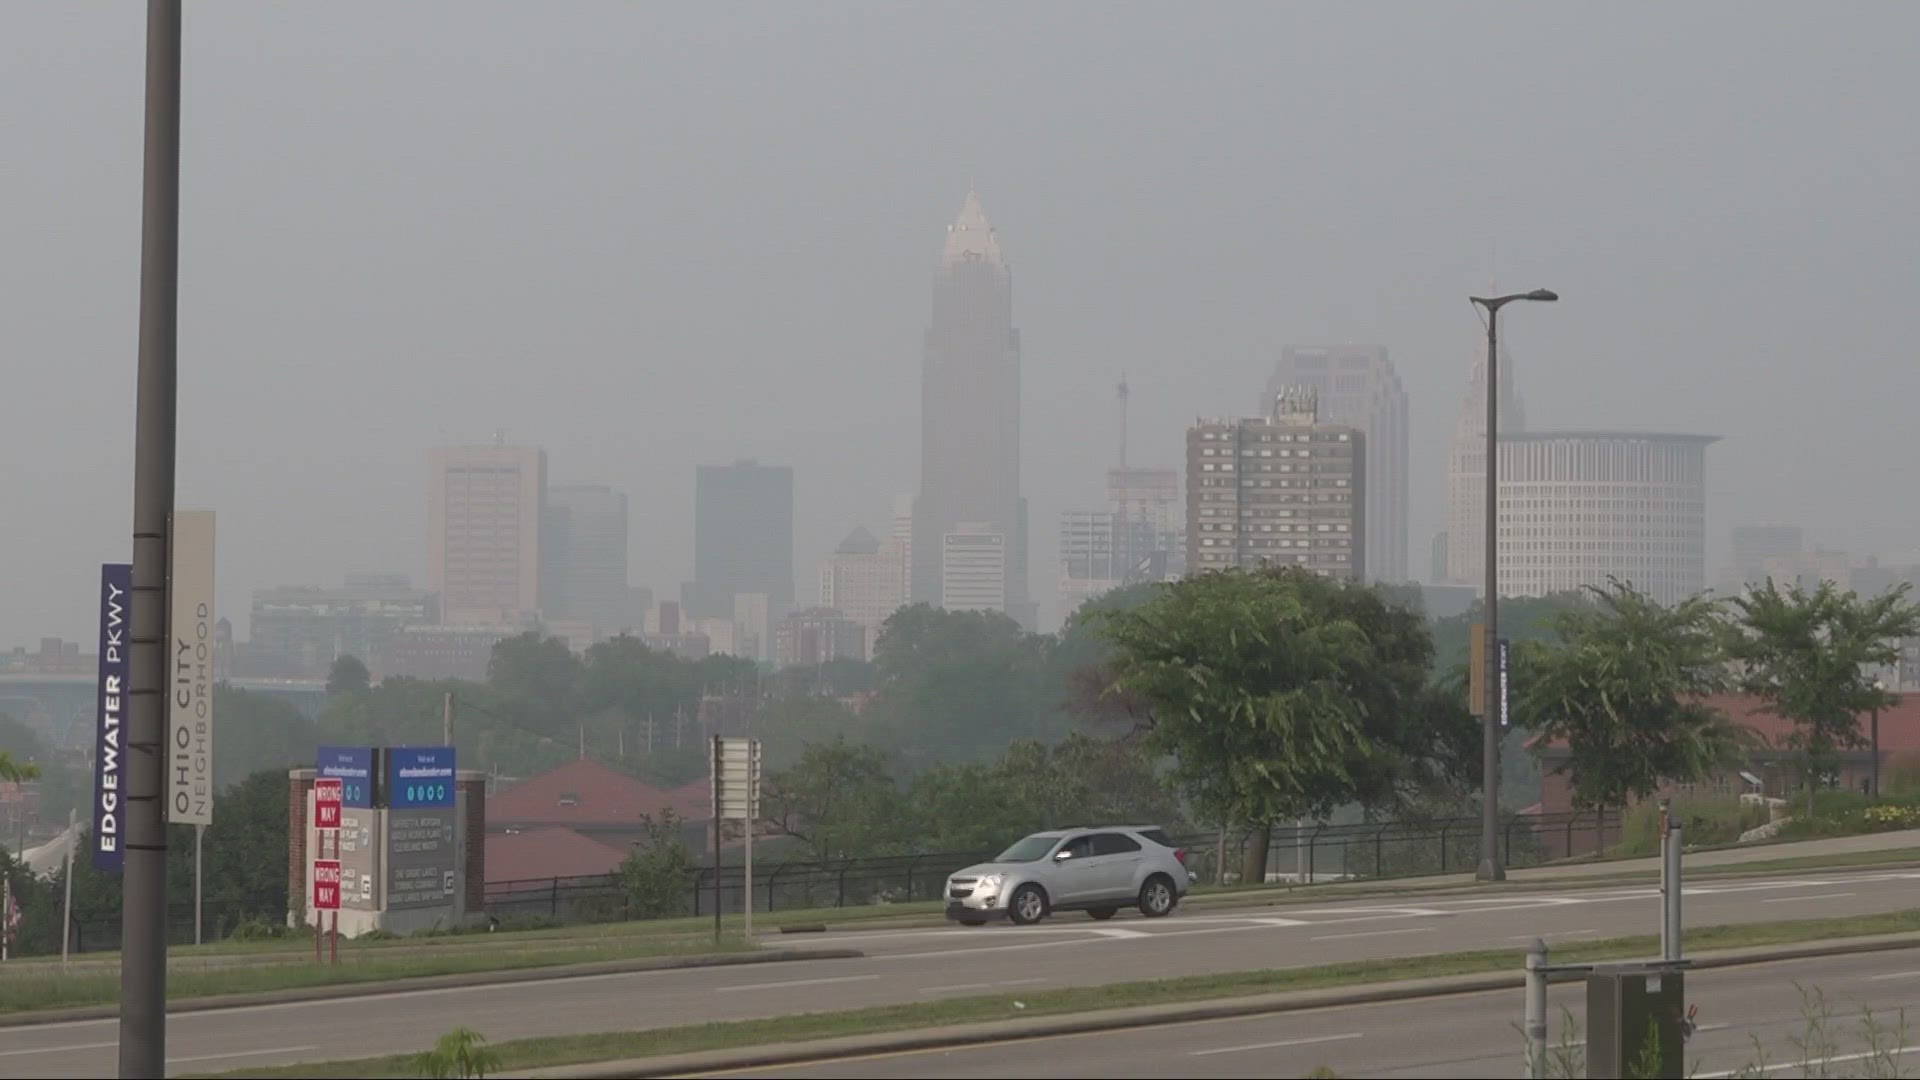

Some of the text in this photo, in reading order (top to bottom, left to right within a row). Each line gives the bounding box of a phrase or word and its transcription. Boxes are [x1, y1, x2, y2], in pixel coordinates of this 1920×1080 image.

[195, 602, 208, 816] NEIGHBORHOOD
[101, 583, 123, 852] EDGEWATER PKWY
[176, 638, 191, 814] OHIO CITY
[316, 786, 342, 801] WRONG
[320, 807, 336, 822] WAY
[315, 867, 339, 883] WRONG
[318, 888, 334, 904] WAY
